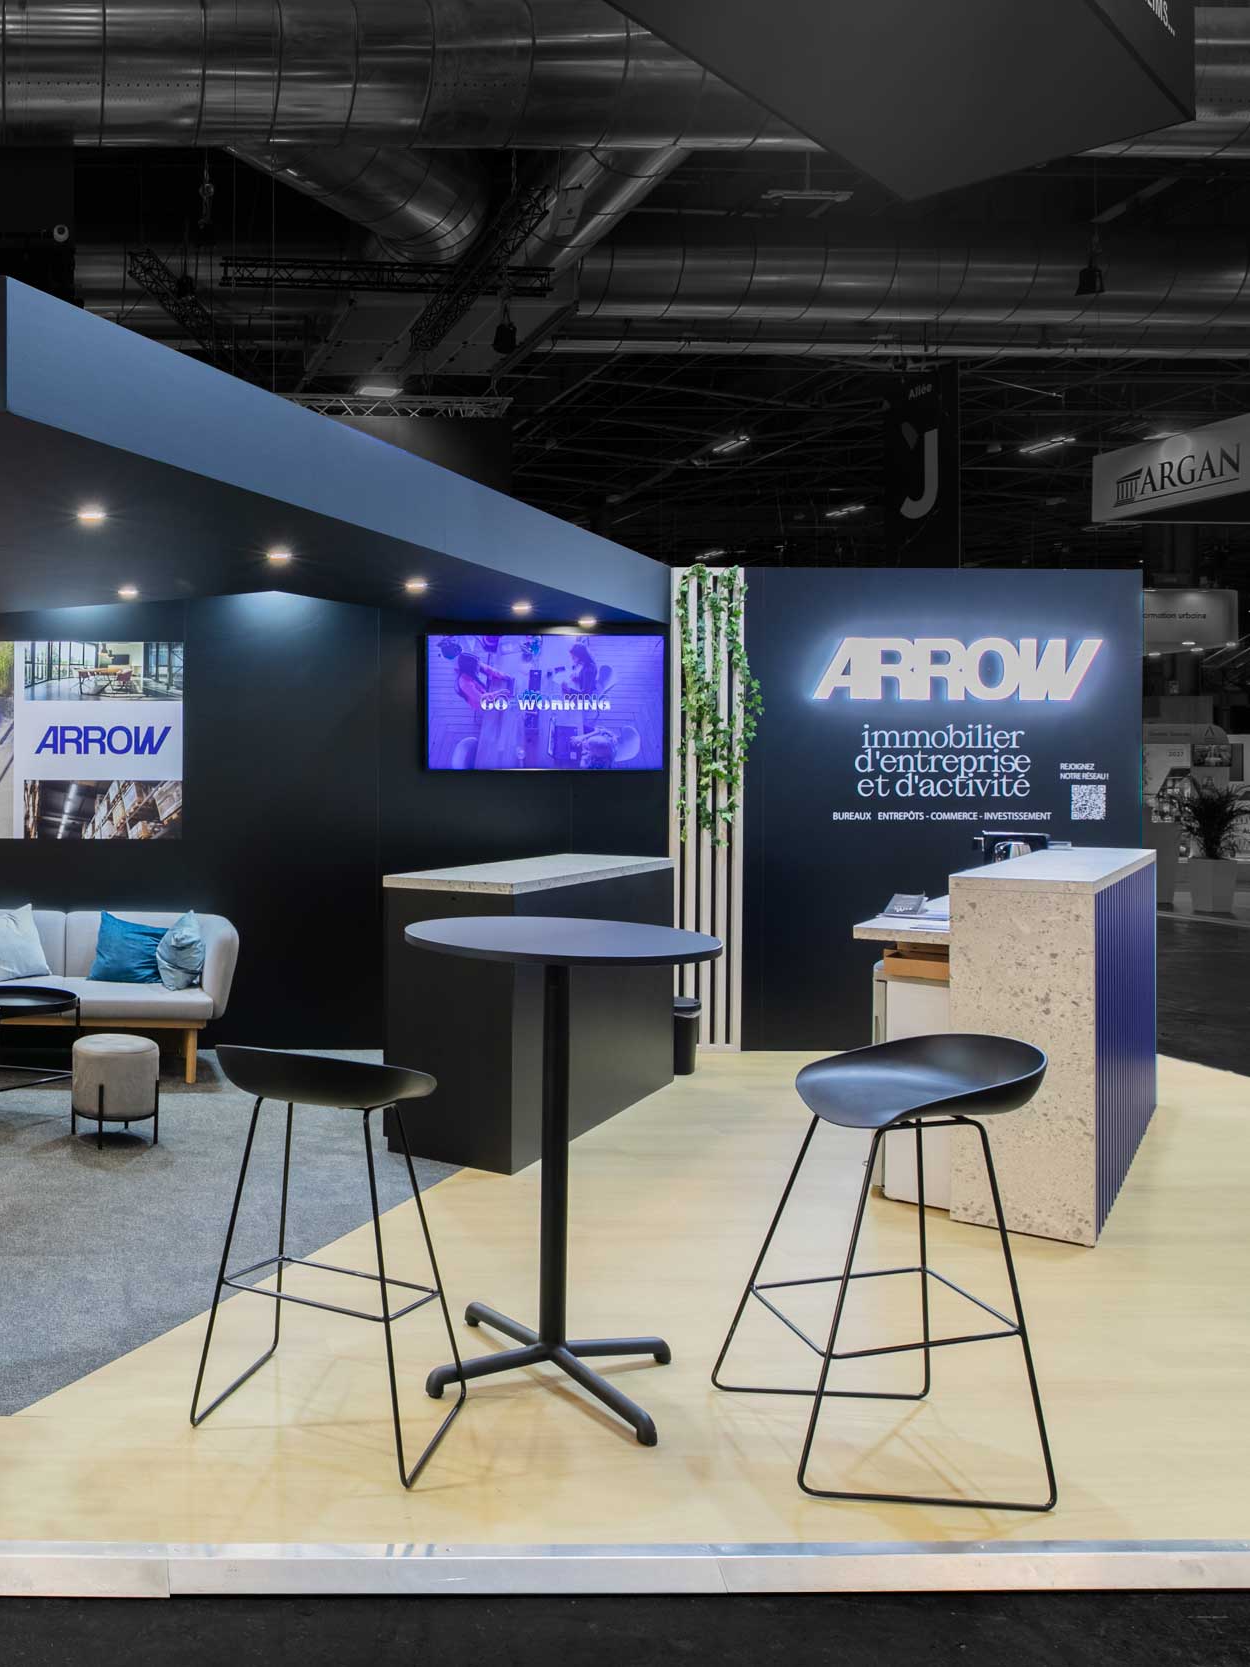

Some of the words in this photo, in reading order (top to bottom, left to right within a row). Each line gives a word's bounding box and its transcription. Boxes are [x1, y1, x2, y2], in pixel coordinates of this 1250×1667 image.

[899, 427, 938, 519] J
[1139, 442, 1240, 496] ARGAN
[812, 637, 1103, 701] ARROW
[34, 726, 171, 755] ARROW
[861, 724, 1025, 748] immobilier
[854, 748, 1031, 779] d'entreprise
[857, 774, 890, 797] et
[895, 773, 1031, 797] d'activité
[833, 812, 872, 821] BUREAUX
[878, 810, 924, 821] ENTREPÔTS
[930, 812, 978, 821] COMMERCE
[984, 812, 1052, 821] INVESTISSEMENT
